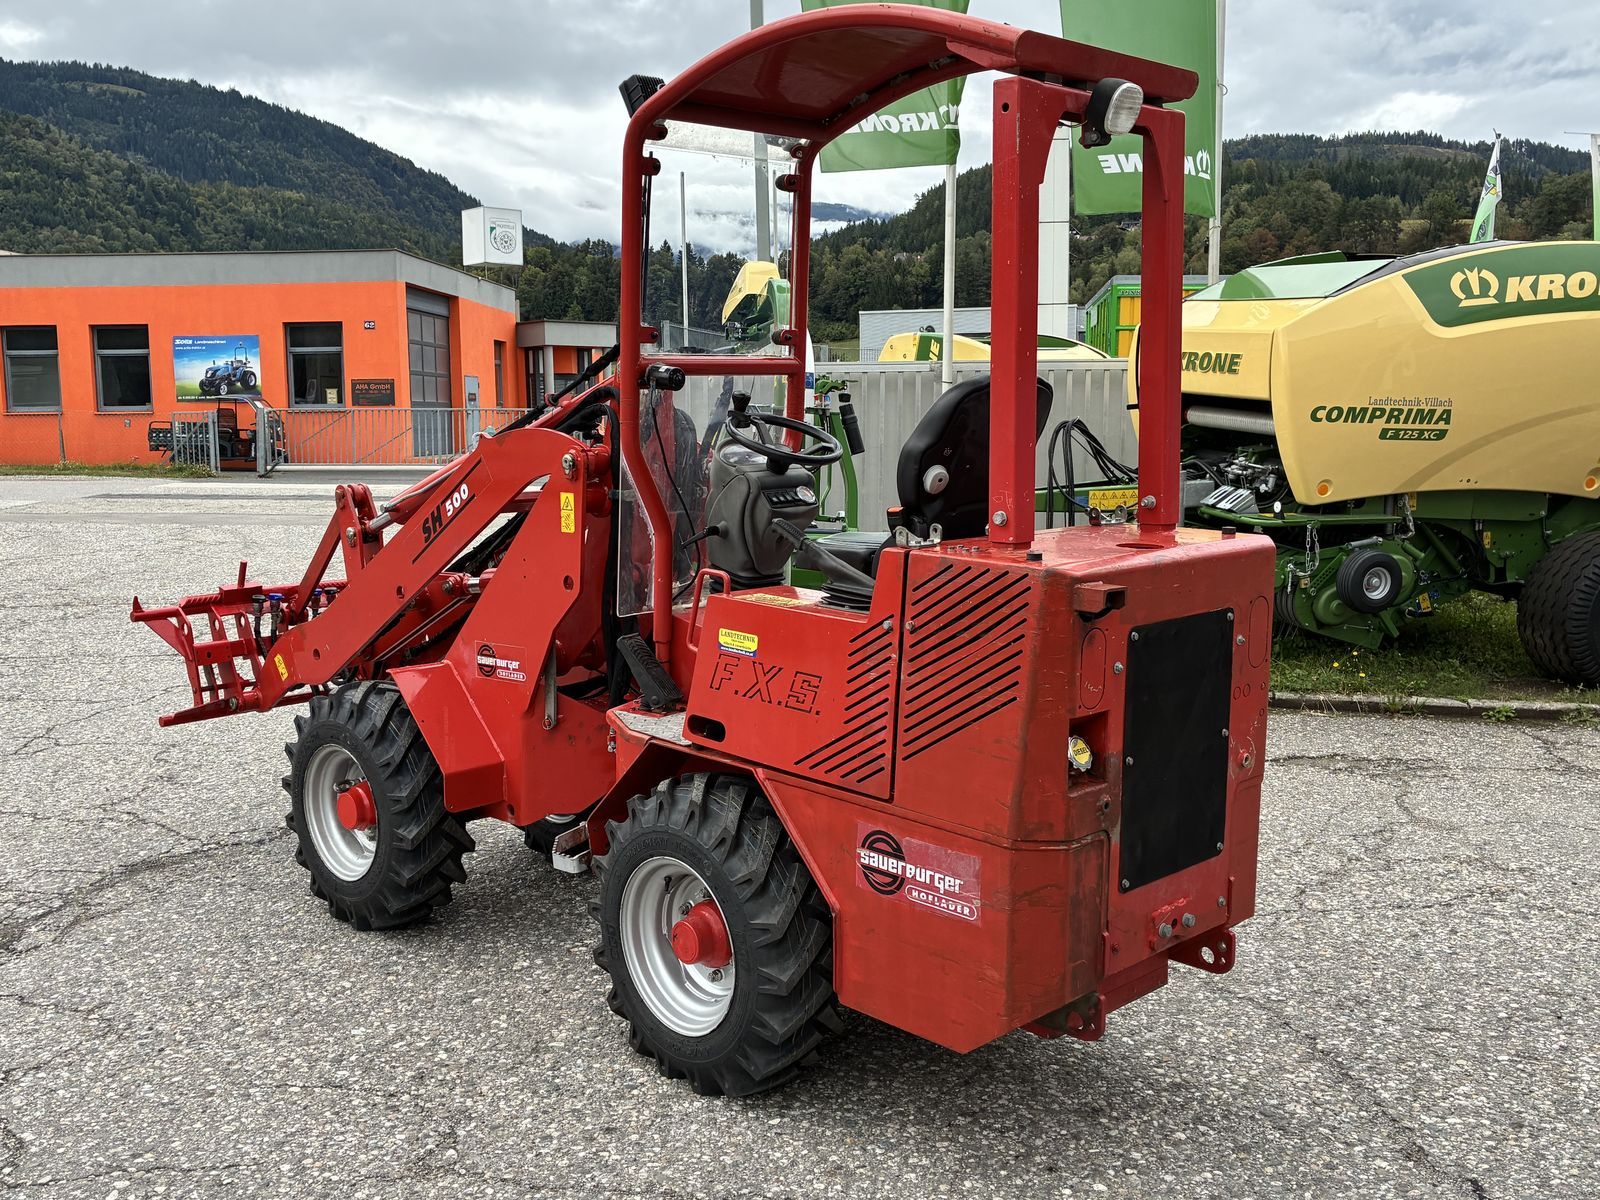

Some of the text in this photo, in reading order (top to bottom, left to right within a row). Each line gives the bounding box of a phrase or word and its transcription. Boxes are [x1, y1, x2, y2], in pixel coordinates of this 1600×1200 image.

[1505, 271, 1600, 303] KRO
[1368, 396, 1453, 407] Landtechnik-Villach
[1310, 405, 1452, 425] COMPRIMA
[1386, 430, 1440, 440] F 125 XC
[422, 483, 469, 544] SH 500
[720, 629, 757, 644] LANDTECHNIK
[911, 889, 971, 916] HOFLADER
